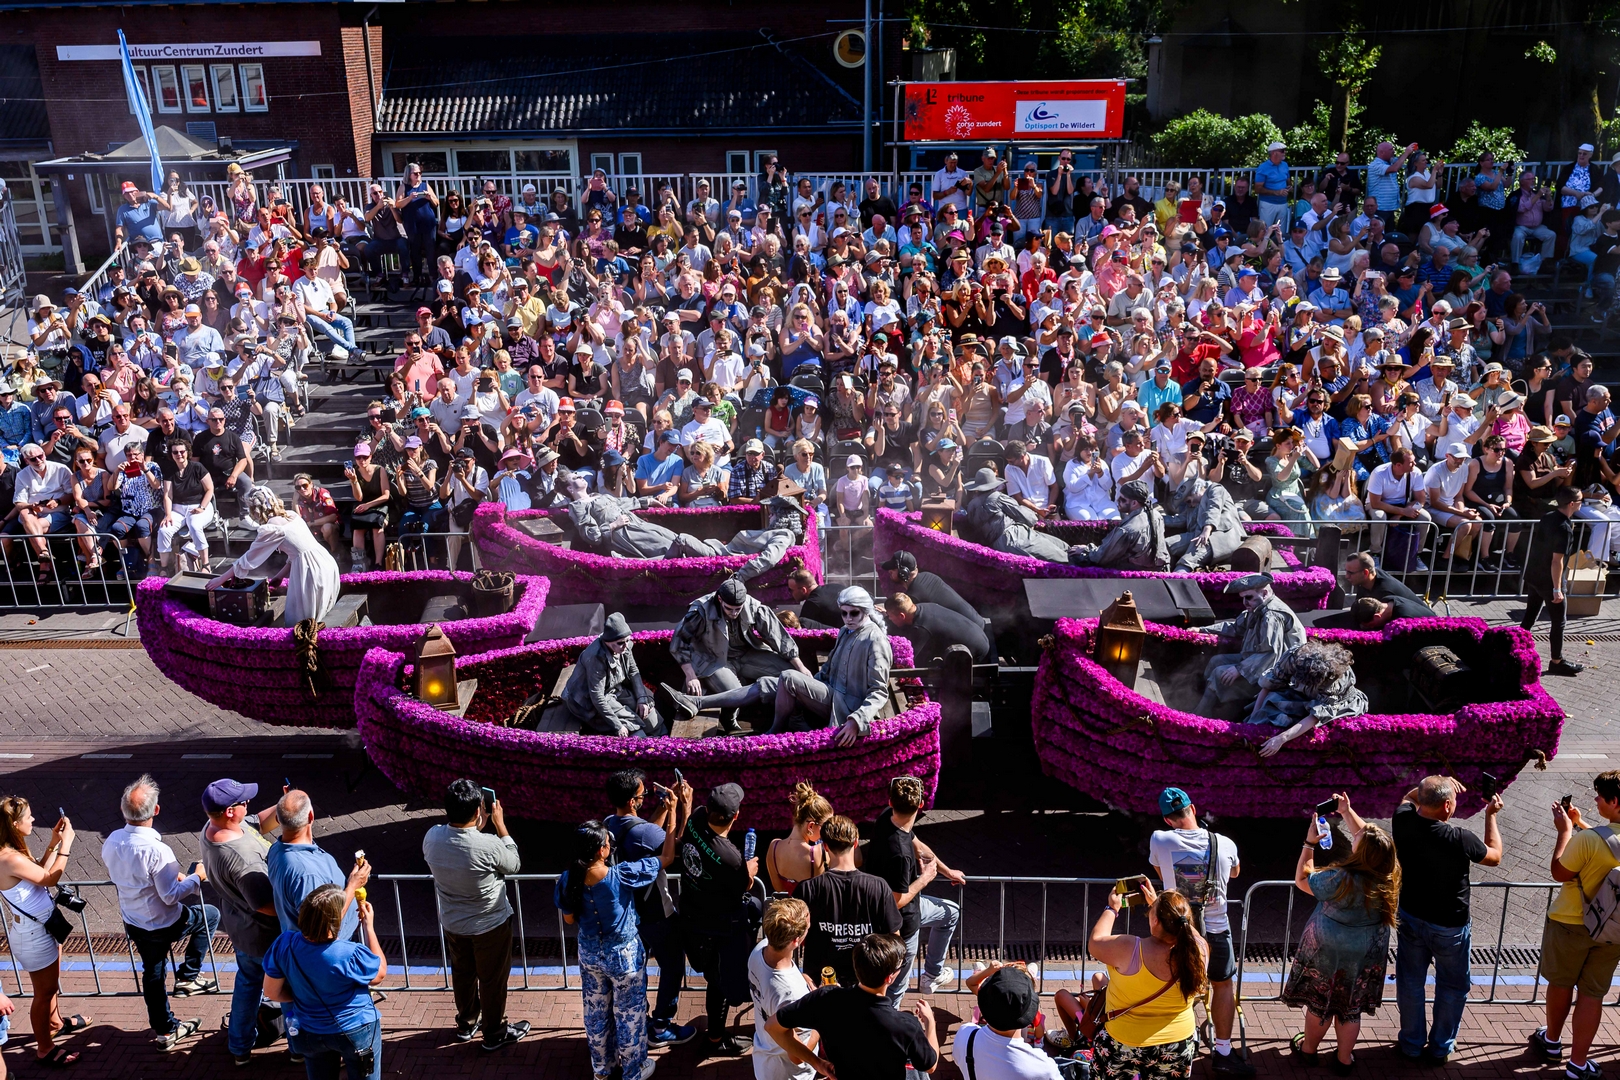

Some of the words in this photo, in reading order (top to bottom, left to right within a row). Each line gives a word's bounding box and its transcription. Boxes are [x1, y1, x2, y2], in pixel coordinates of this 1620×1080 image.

[947, 93, 985, 102] tribune
[1024, 122, 1058, 130] Optisport
[687, 818, 722, 865] QUOTRELL
